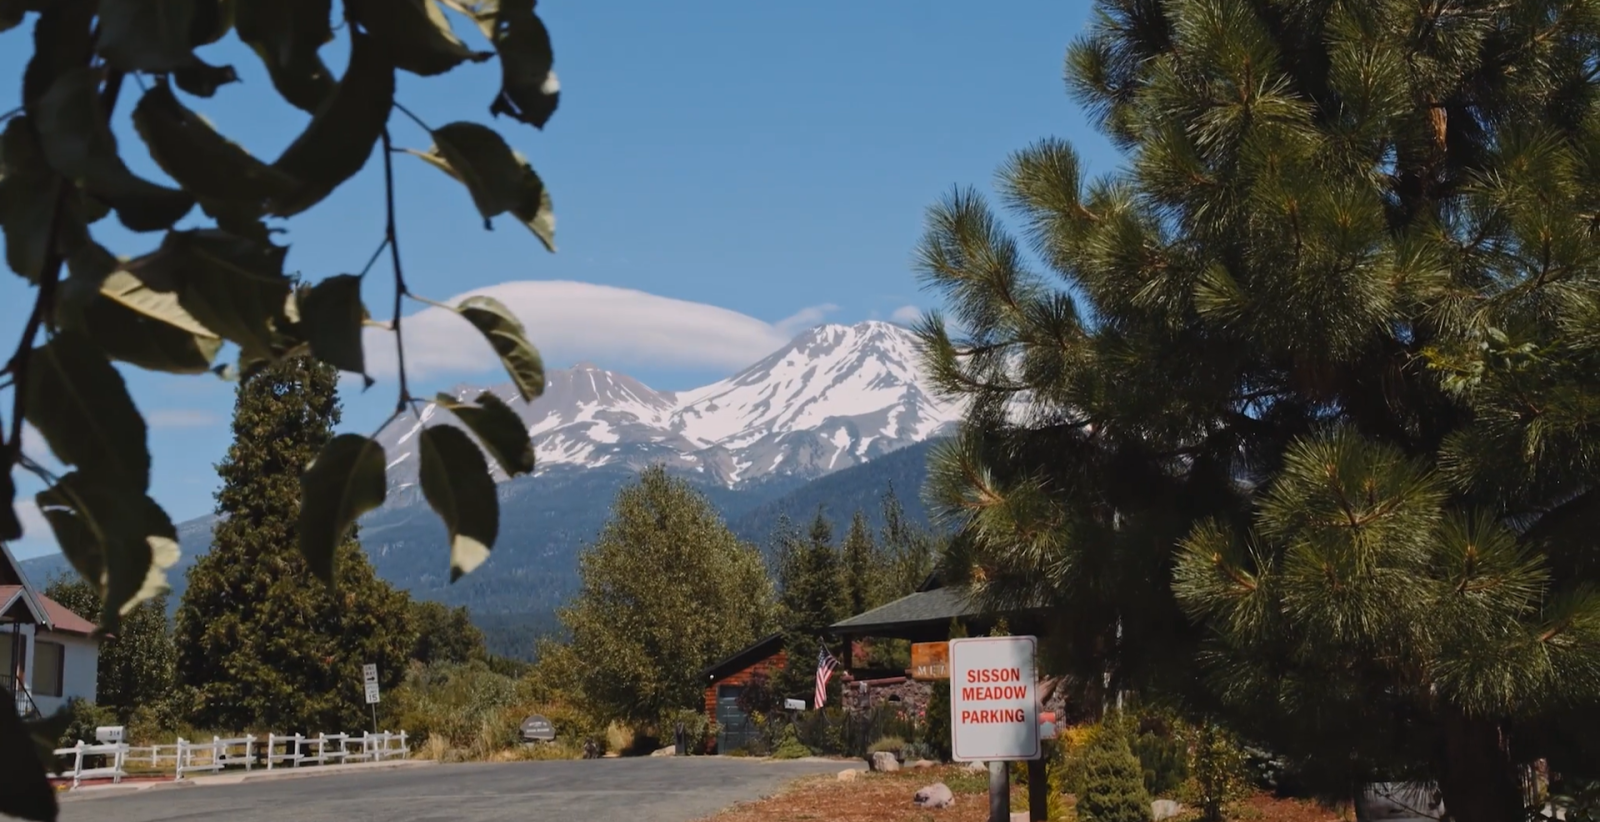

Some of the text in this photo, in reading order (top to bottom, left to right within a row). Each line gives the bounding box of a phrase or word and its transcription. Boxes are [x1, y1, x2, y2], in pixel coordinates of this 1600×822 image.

[967, 668, 1020, 683] SISSON
[962, 686, 1027, 701] MEADOW
[962, 709, 1025, 724] PARKING
